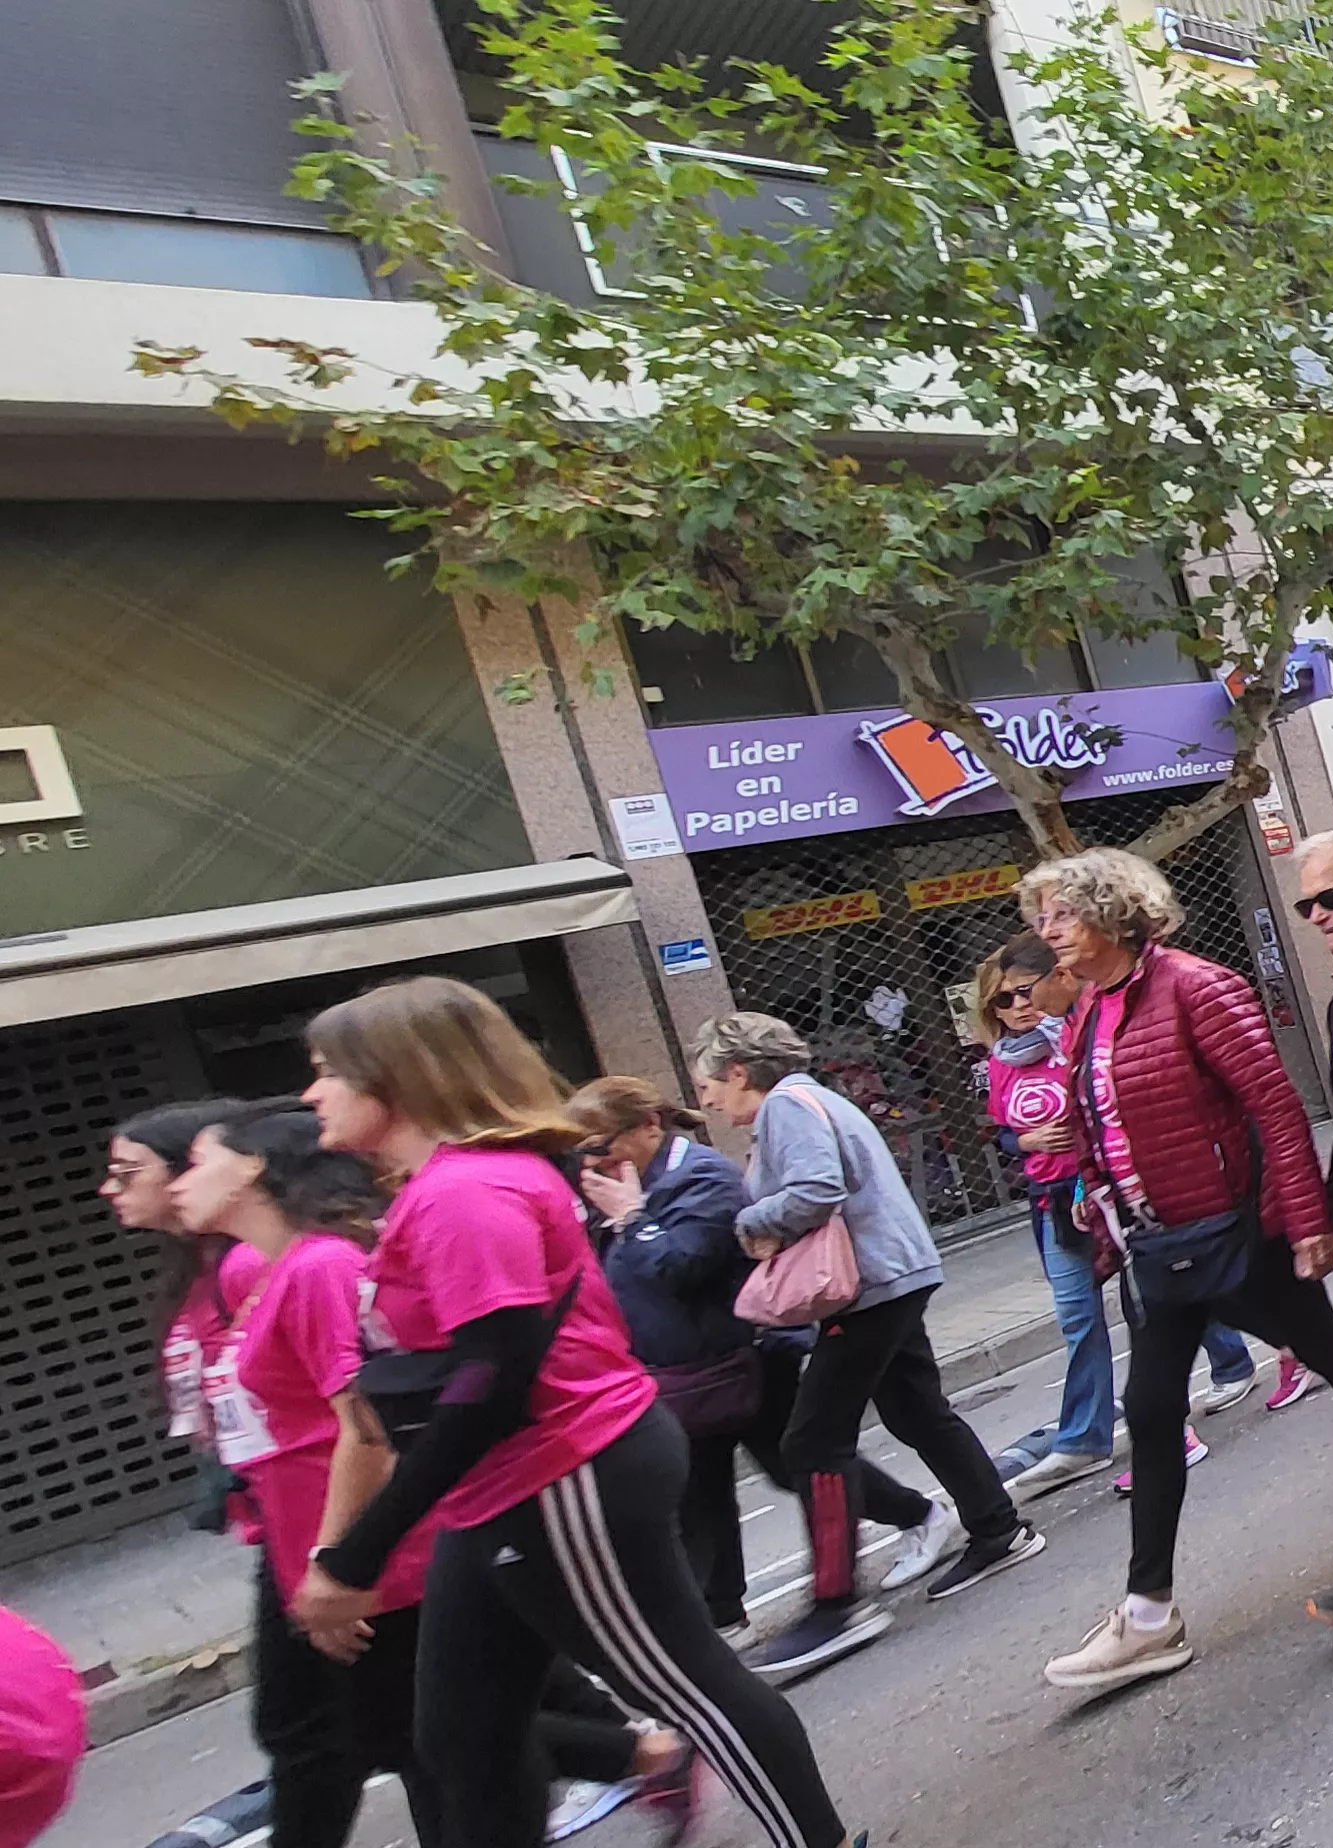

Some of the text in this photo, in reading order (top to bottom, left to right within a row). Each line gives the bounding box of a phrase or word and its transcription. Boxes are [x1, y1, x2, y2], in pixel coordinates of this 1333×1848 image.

[707, 739, 804, 770] Líder
[735, 774, 782, 798] en
[1101, 758, 1234, 788] www.folder.es
[685, 791, 860, 837] Papelería
[0, 828, 91, 855] RE
